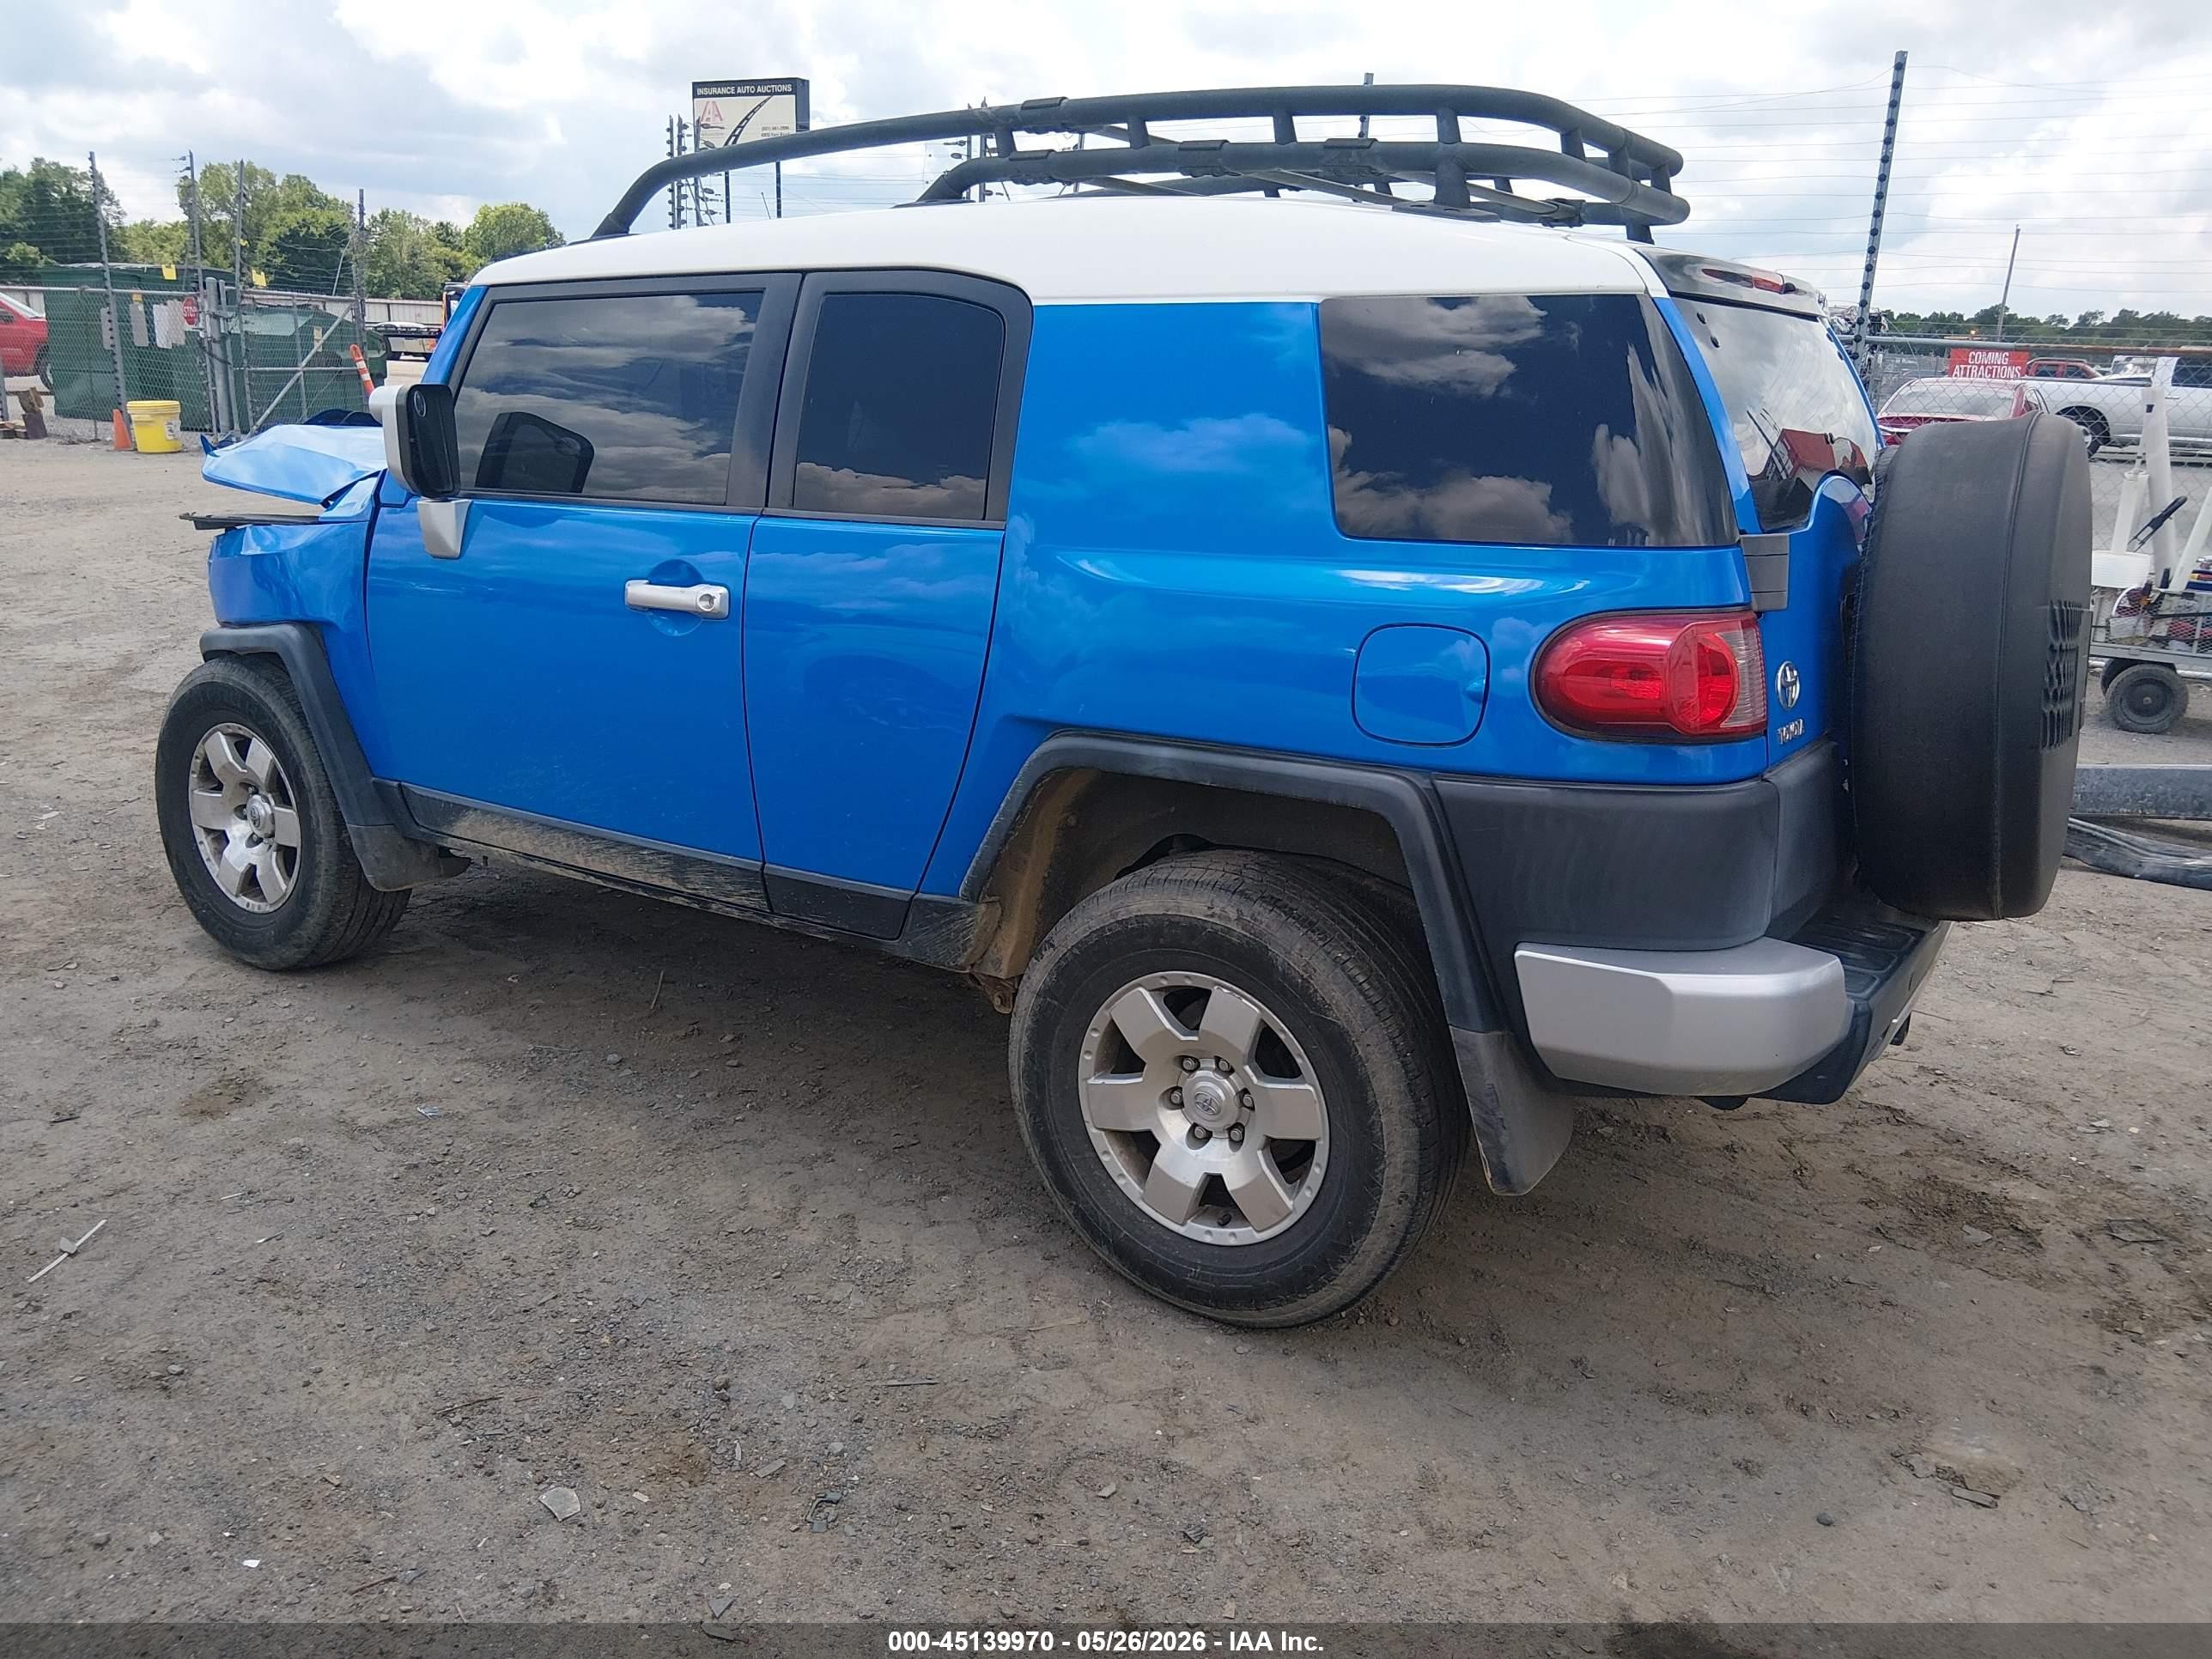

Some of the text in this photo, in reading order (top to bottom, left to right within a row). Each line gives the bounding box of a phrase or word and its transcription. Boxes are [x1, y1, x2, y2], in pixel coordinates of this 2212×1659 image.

[696, 83, 793, 96] INSURANCE AUTO AUCTIONS
[1968, 351, 2009, 365] COMING
[1952, 365, 2021, 379] ATTRACTIONS
